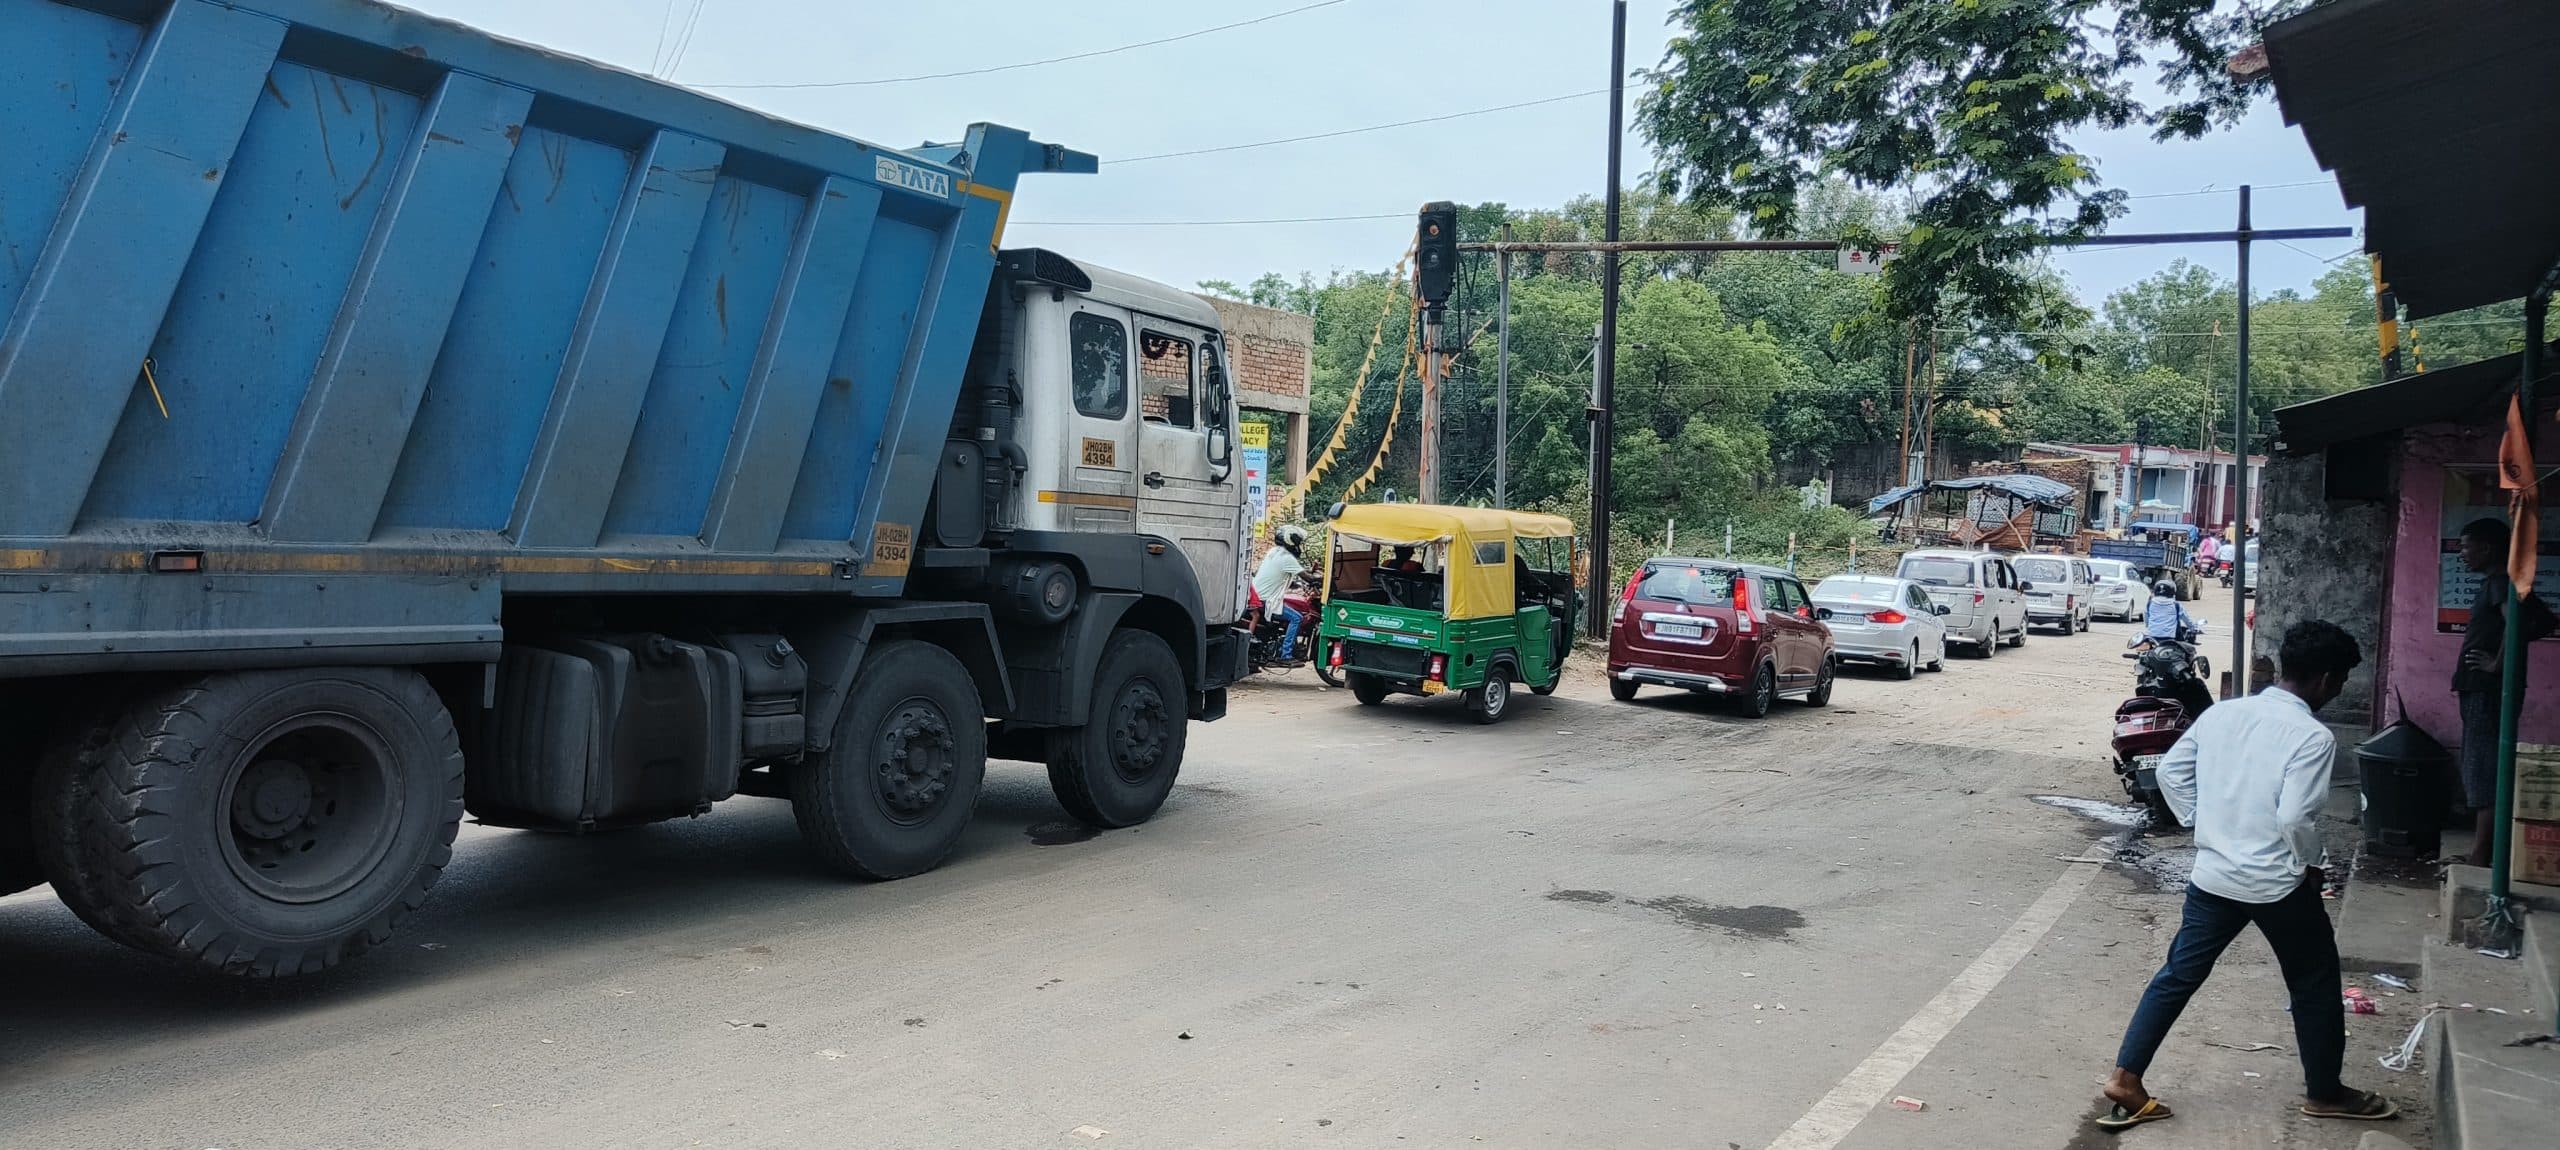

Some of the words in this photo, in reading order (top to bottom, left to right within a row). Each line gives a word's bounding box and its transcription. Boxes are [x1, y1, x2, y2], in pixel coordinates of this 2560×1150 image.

[898, 164, 947, 196] TATA
[1239, 425, 1265, 435] LLEGE
[1240, 436, 1260, 445] ACY
[1084, 452, 1113, 465] 4394
[876, 545, 907, 560] 4394
